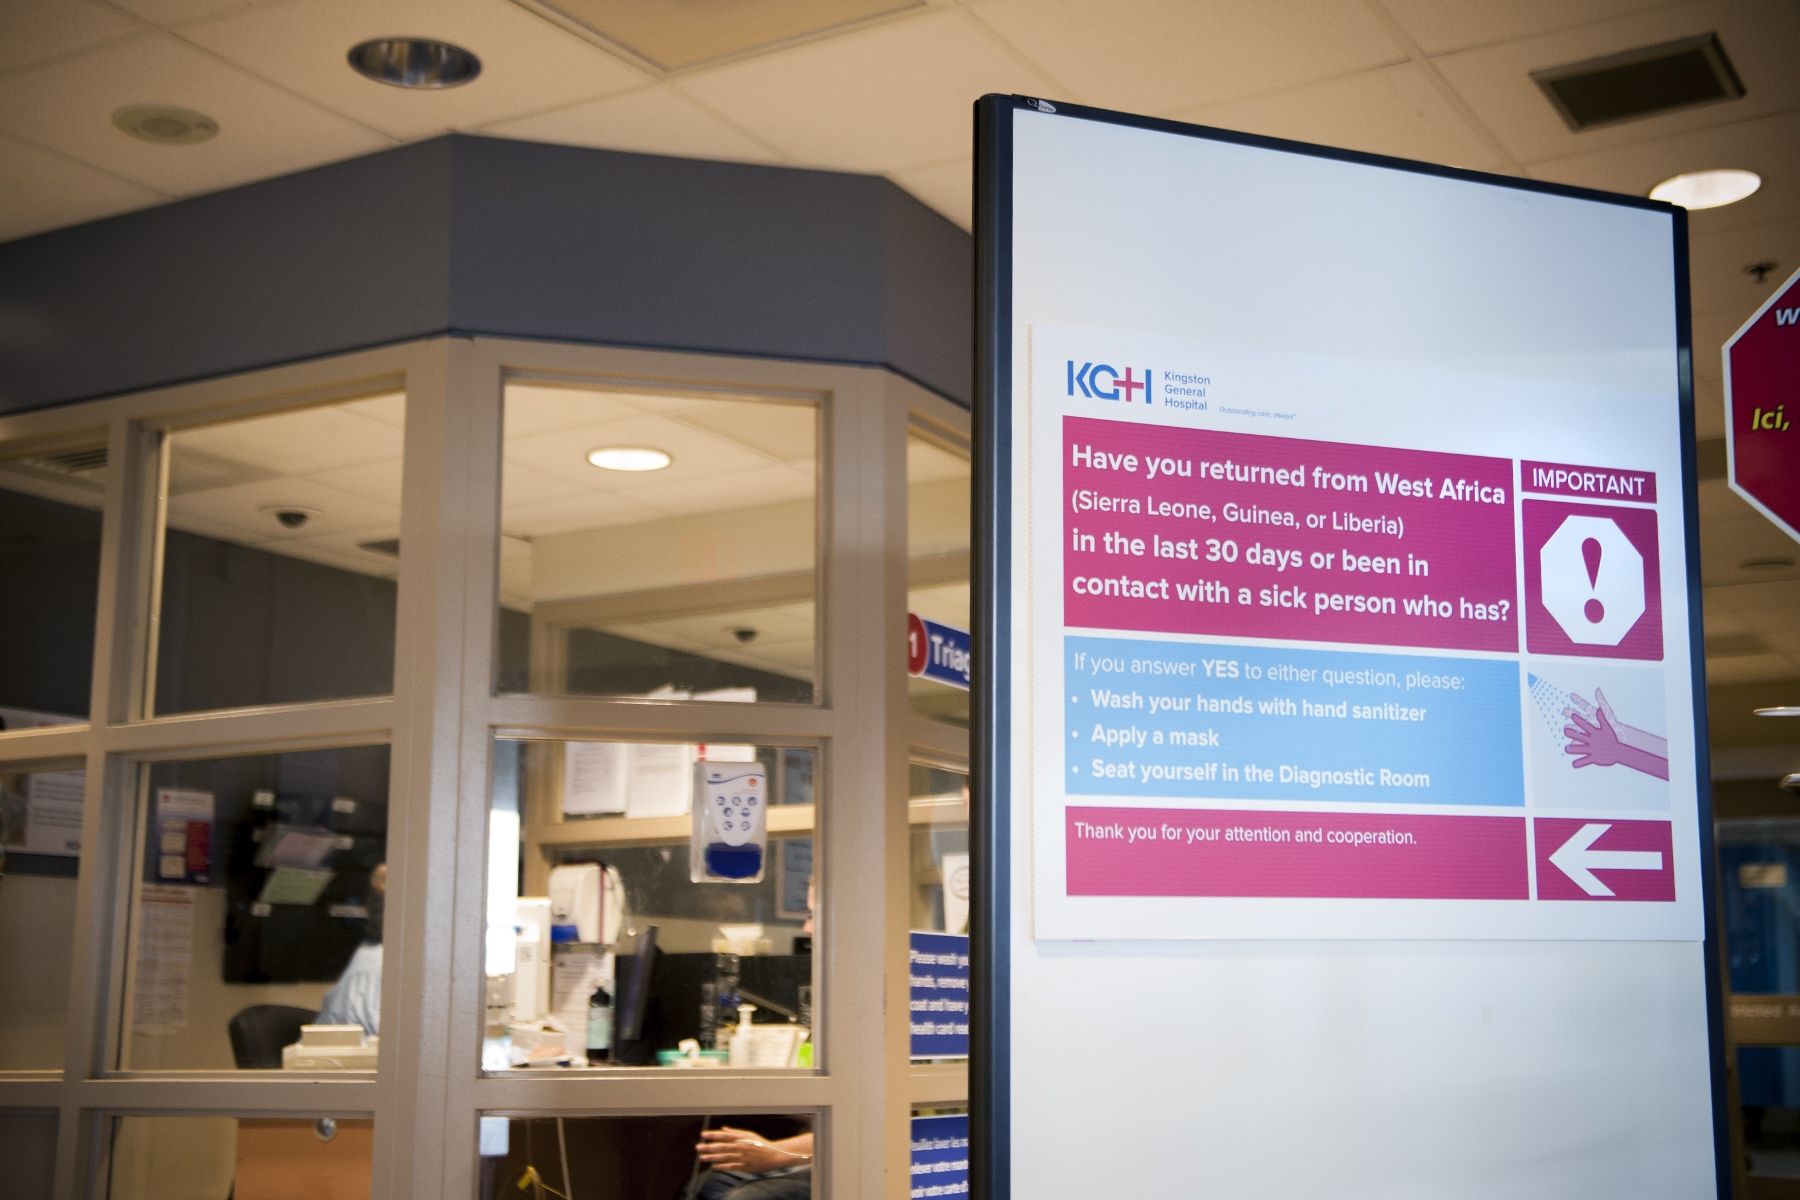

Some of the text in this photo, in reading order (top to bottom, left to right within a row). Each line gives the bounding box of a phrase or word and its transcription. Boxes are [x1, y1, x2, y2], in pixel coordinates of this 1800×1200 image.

[1067, 360, 1152, 404] KGH
[1164, 371, 1211, 385] Kingston
[1164, 384, 1206, 397] General
[1164, 397, 1208, 411] Hospital
[1219, 406, 1256, 418] Outstanding
[1752, 405, 1790, 432] Ici,
[1072, 444, 1505, 505] Have you returned from West Africa
[1533, 468, 1645, 496] IMPORTANT
[1072, 489, 1404, 539] (Sierra Leone, Guinea, or Liberia)
[1072, 528, 1429, 577] in the last 30 days or been in
[1072, 575, 1510, 622] contact with a sick person who has?
[1074, 652, 1465, 691] If you answer YES to either question, please:
[1091, 689, 1427, 721] Wash your hands with hand sanitizer
[1091, 724, 1219, 748] Apply a mask
[1092, 759, 1430, 788] Seat yourself in the Diagnostic Room
[1074, 822, 1417, 847] Thank you for your attention and cooperation.
[910, 950, 936, 964] Please
[937, 953, 957, 965] wash
[937, 978, 966, 989] remove
[927, 999, 943, 1011] and
